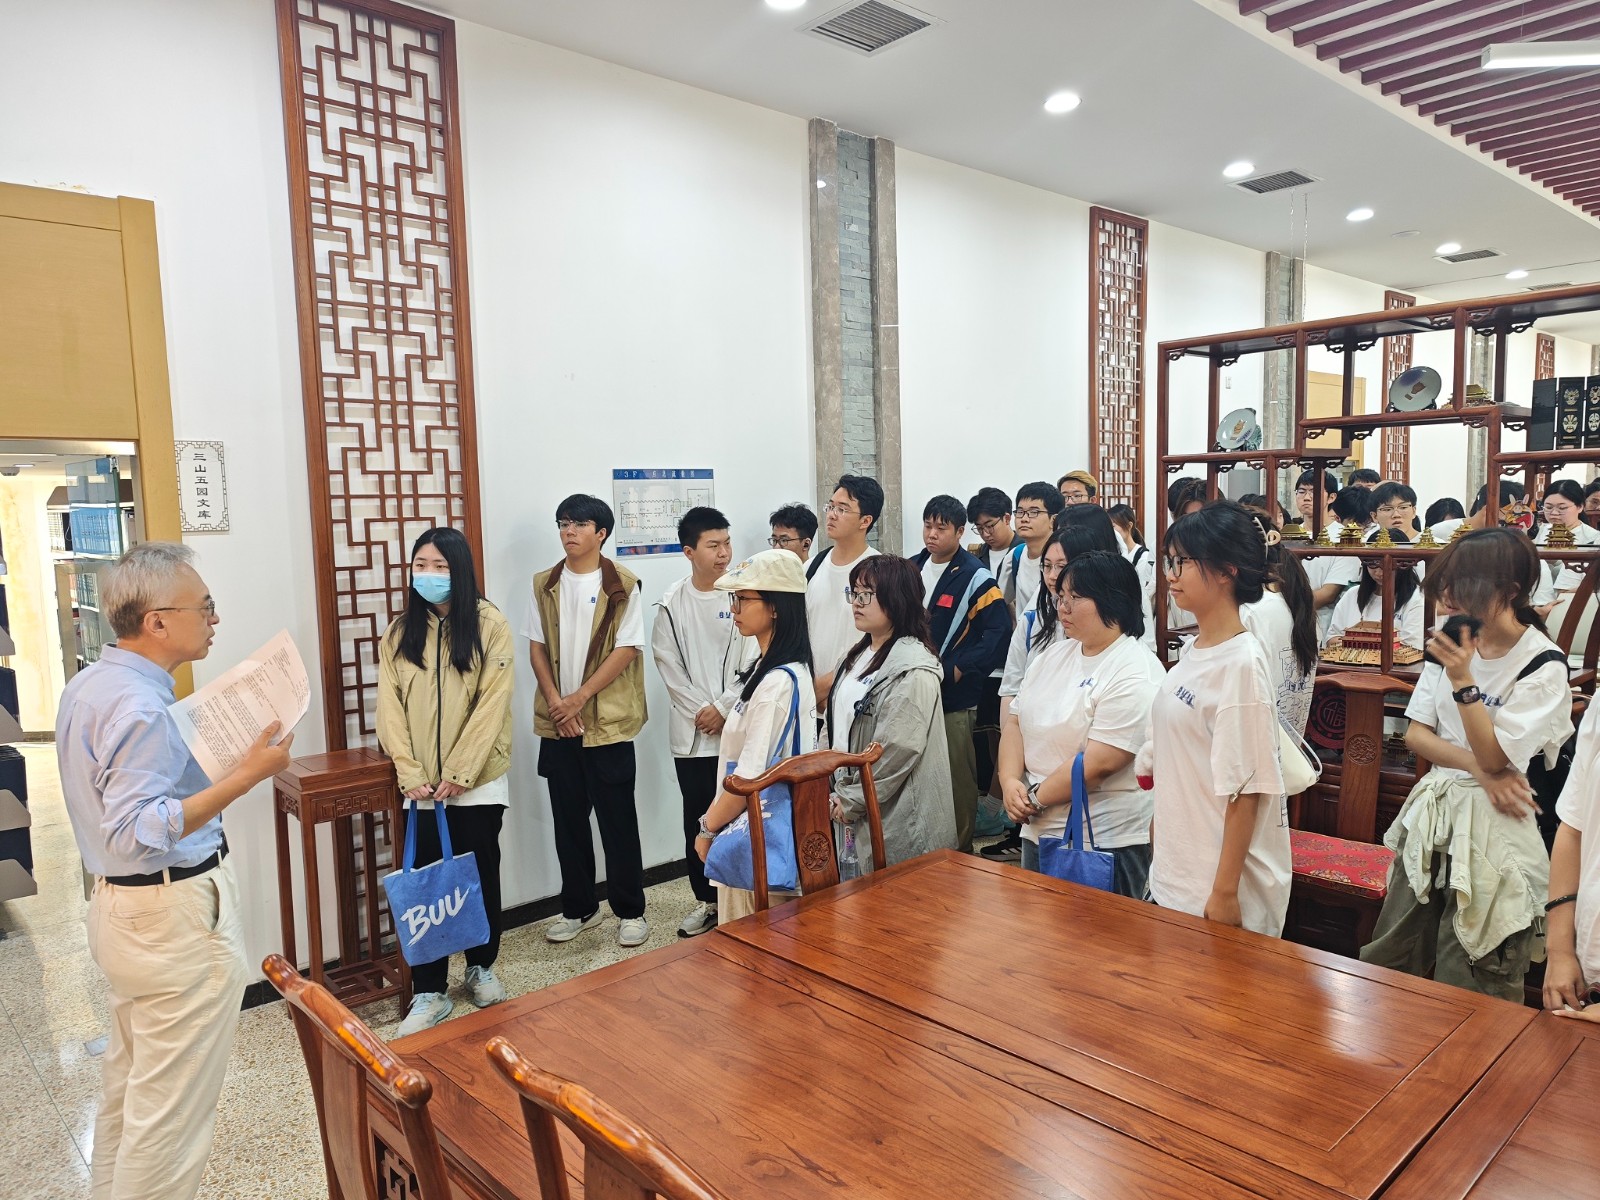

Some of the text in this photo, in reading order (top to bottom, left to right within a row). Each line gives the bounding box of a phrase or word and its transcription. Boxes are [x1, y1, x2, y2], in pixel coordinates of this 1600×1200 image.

[193, 453, 211, 519] 三山五园文库
[400, 886, 471, 947] BUU
